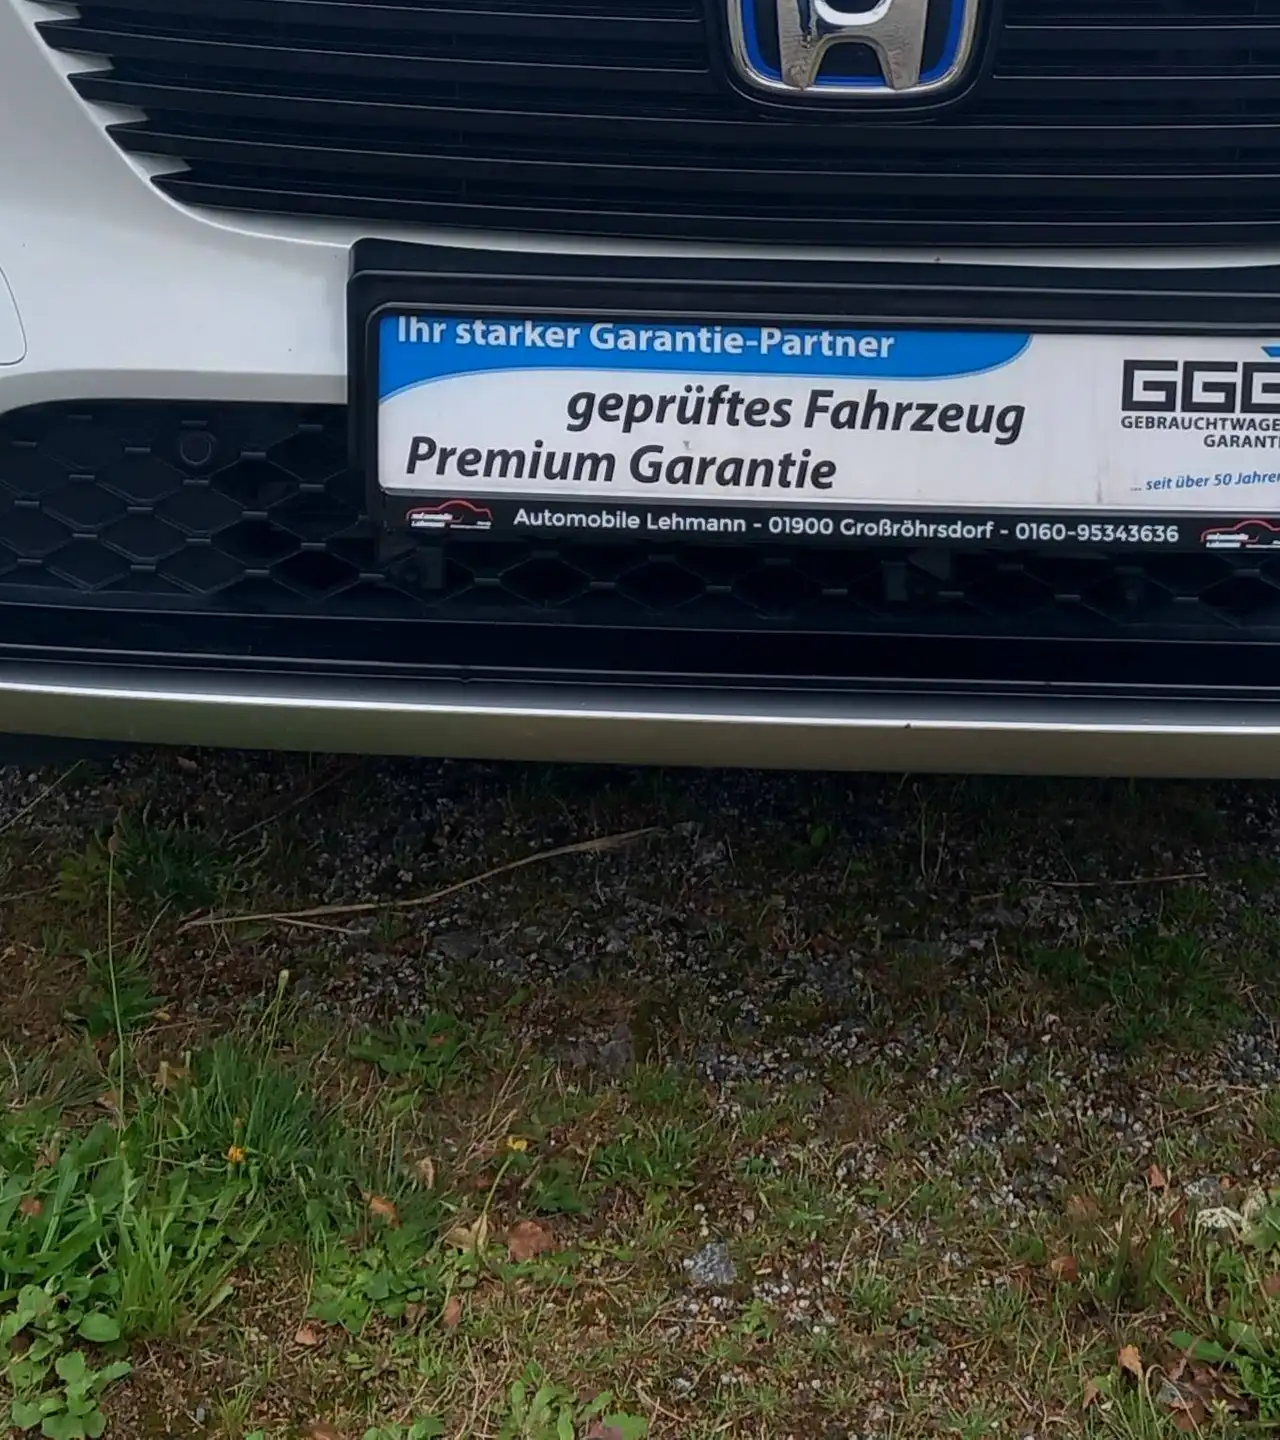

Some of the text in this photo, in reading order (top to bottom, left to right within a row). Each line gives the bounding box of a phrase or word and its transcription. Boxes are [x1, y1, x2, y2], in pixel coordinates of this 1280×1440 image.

[397, 315, 895, 359] Ihr starker Garantie-Partner
[566, 384, 1026, 446] geprüftes Fahrzeug
[405, 436, 838, 490] Premium Garantie
[1145, 477, 1173, 491] seit
[1175, 475, 1210, 489] über
[1212, 473, 1232, 487] 50
[513, 508, 641, 529] Automobile
[647, 512, 747, 532] Lehmann
[768, 516, 834, 535] 01900
[839, 518, 995, 540] Großröhrsdorf
[1015, 522, 1180, 543] 0160-95343636
